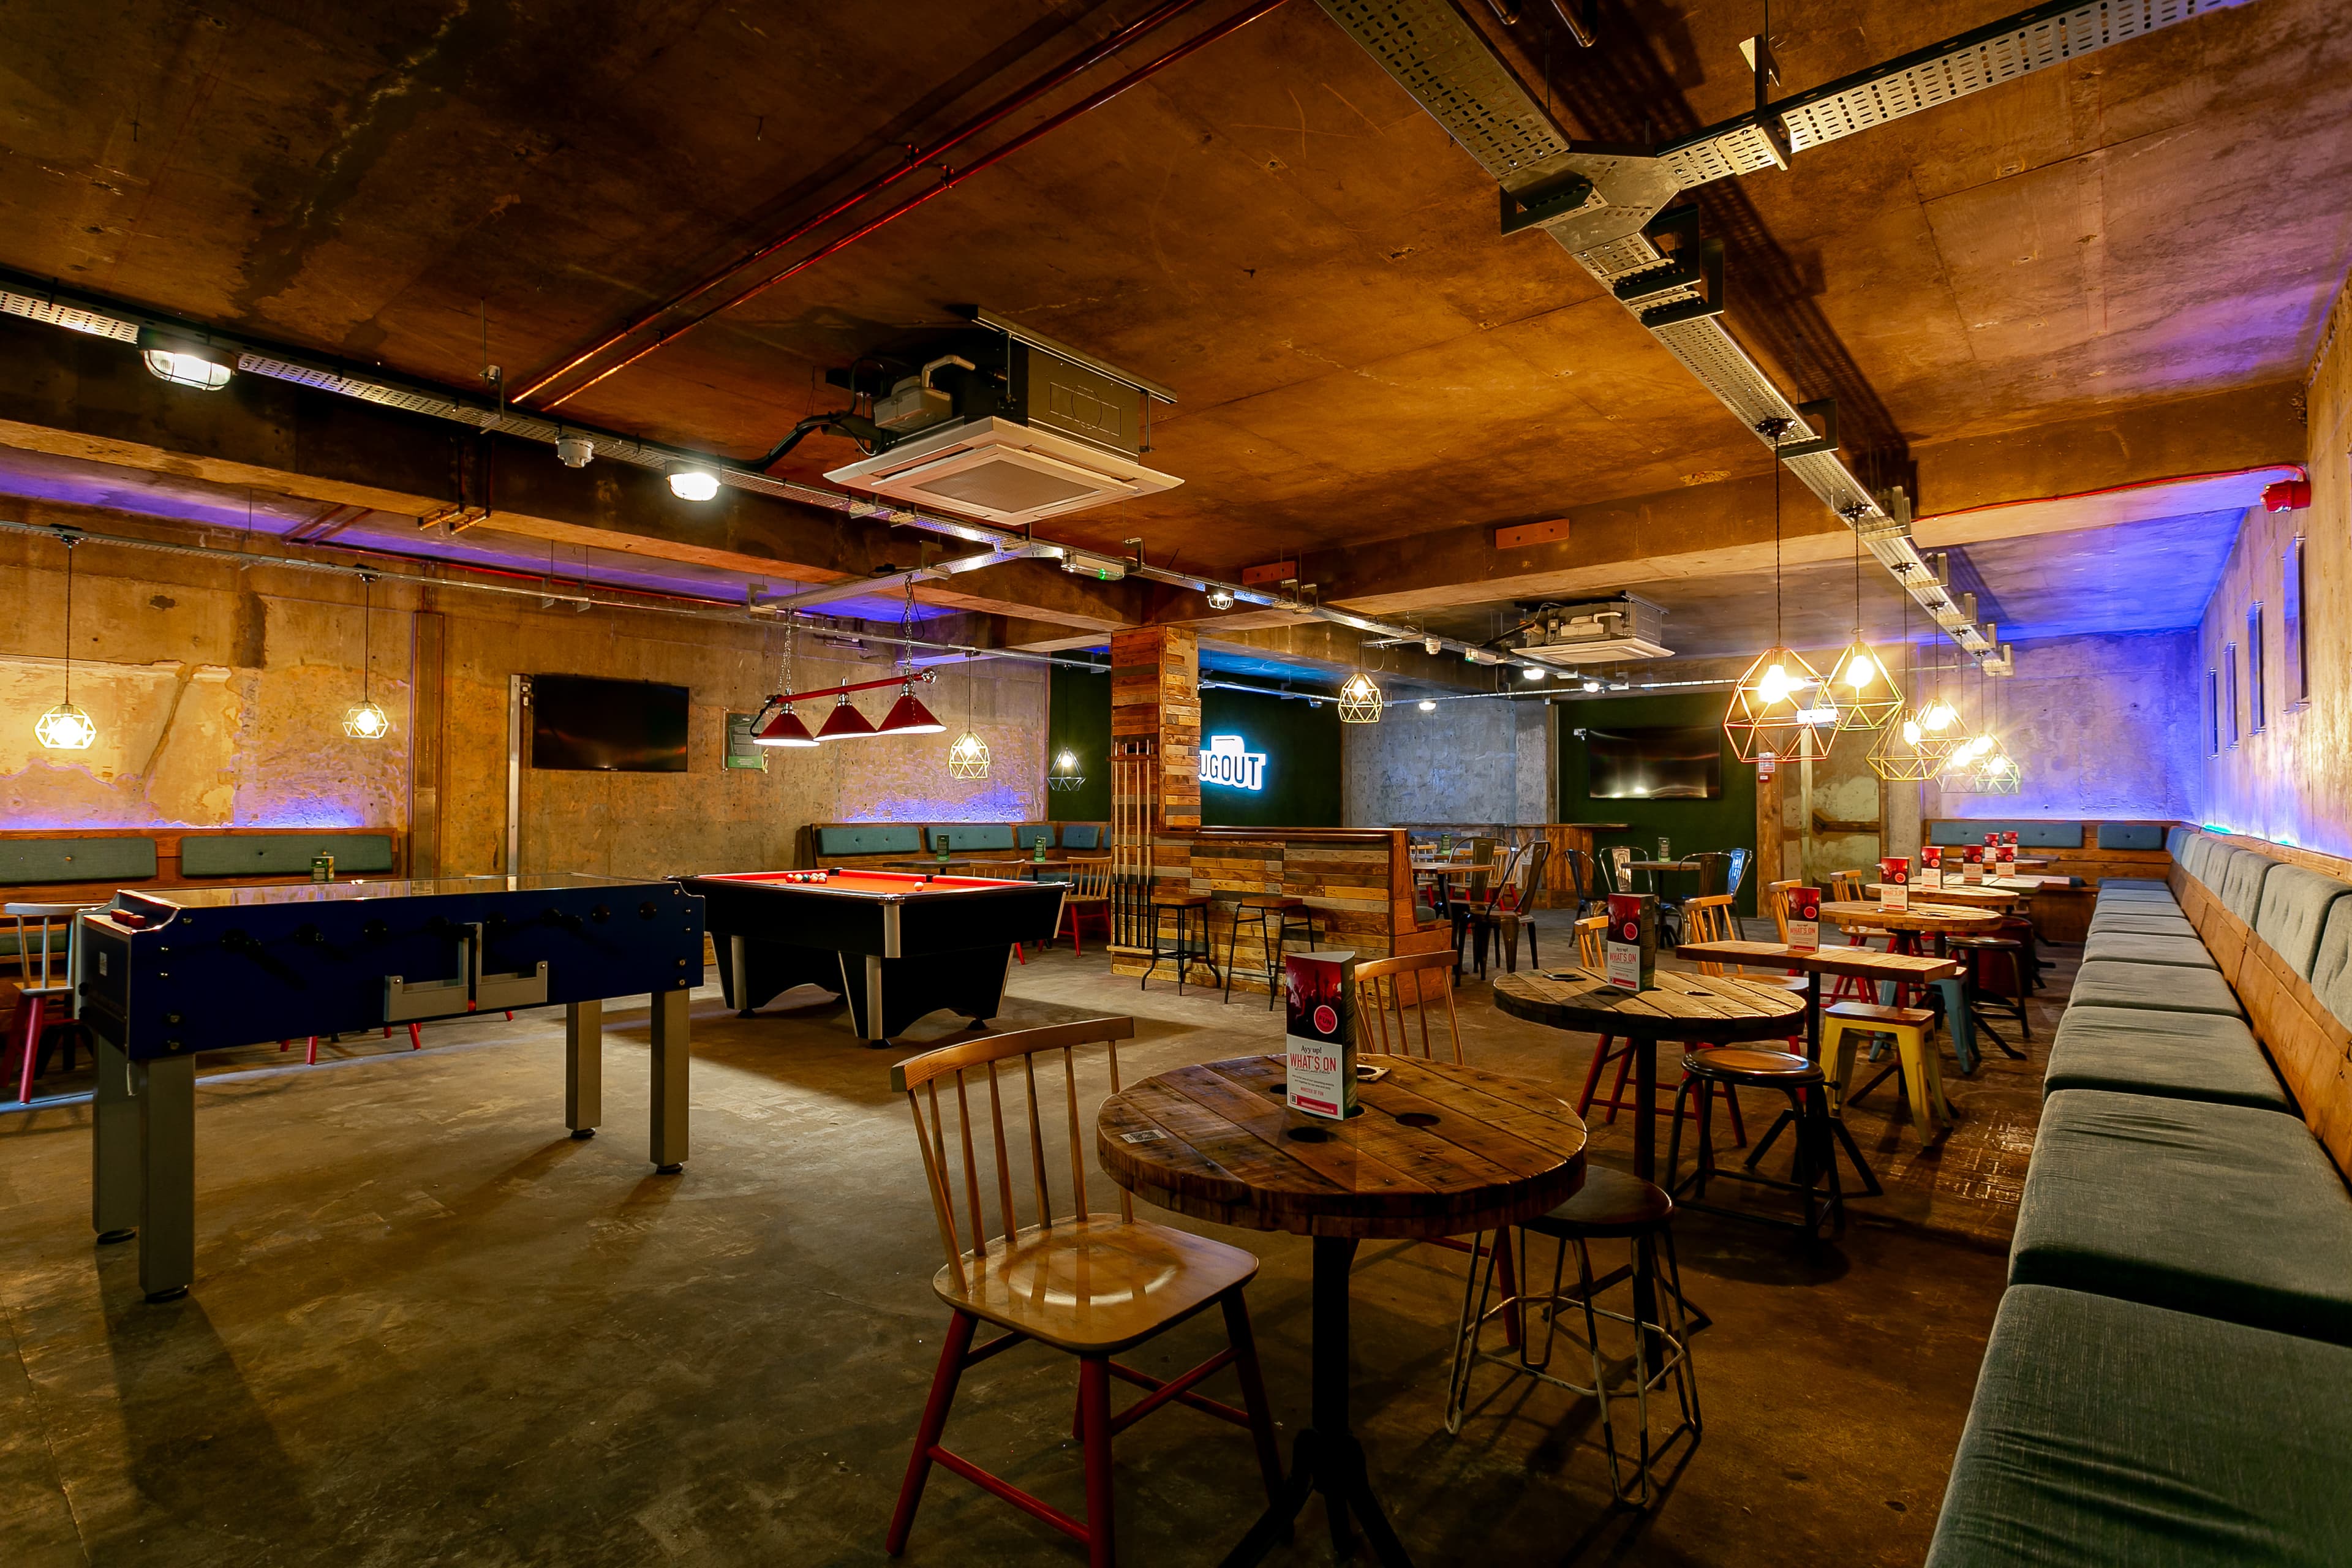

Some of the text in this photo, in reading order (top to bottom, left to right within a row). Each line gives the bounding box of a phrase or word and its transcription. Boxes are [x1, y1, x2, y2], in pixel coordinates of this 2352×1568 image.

[1610, 952, 1636, 962] WHAT'S ON
[1301, 1045, 1311, 1054] Ayy
[1290, 1053, 1320, 1070] WHAT'S
[1323, 1057, 1336, 1071] ON
